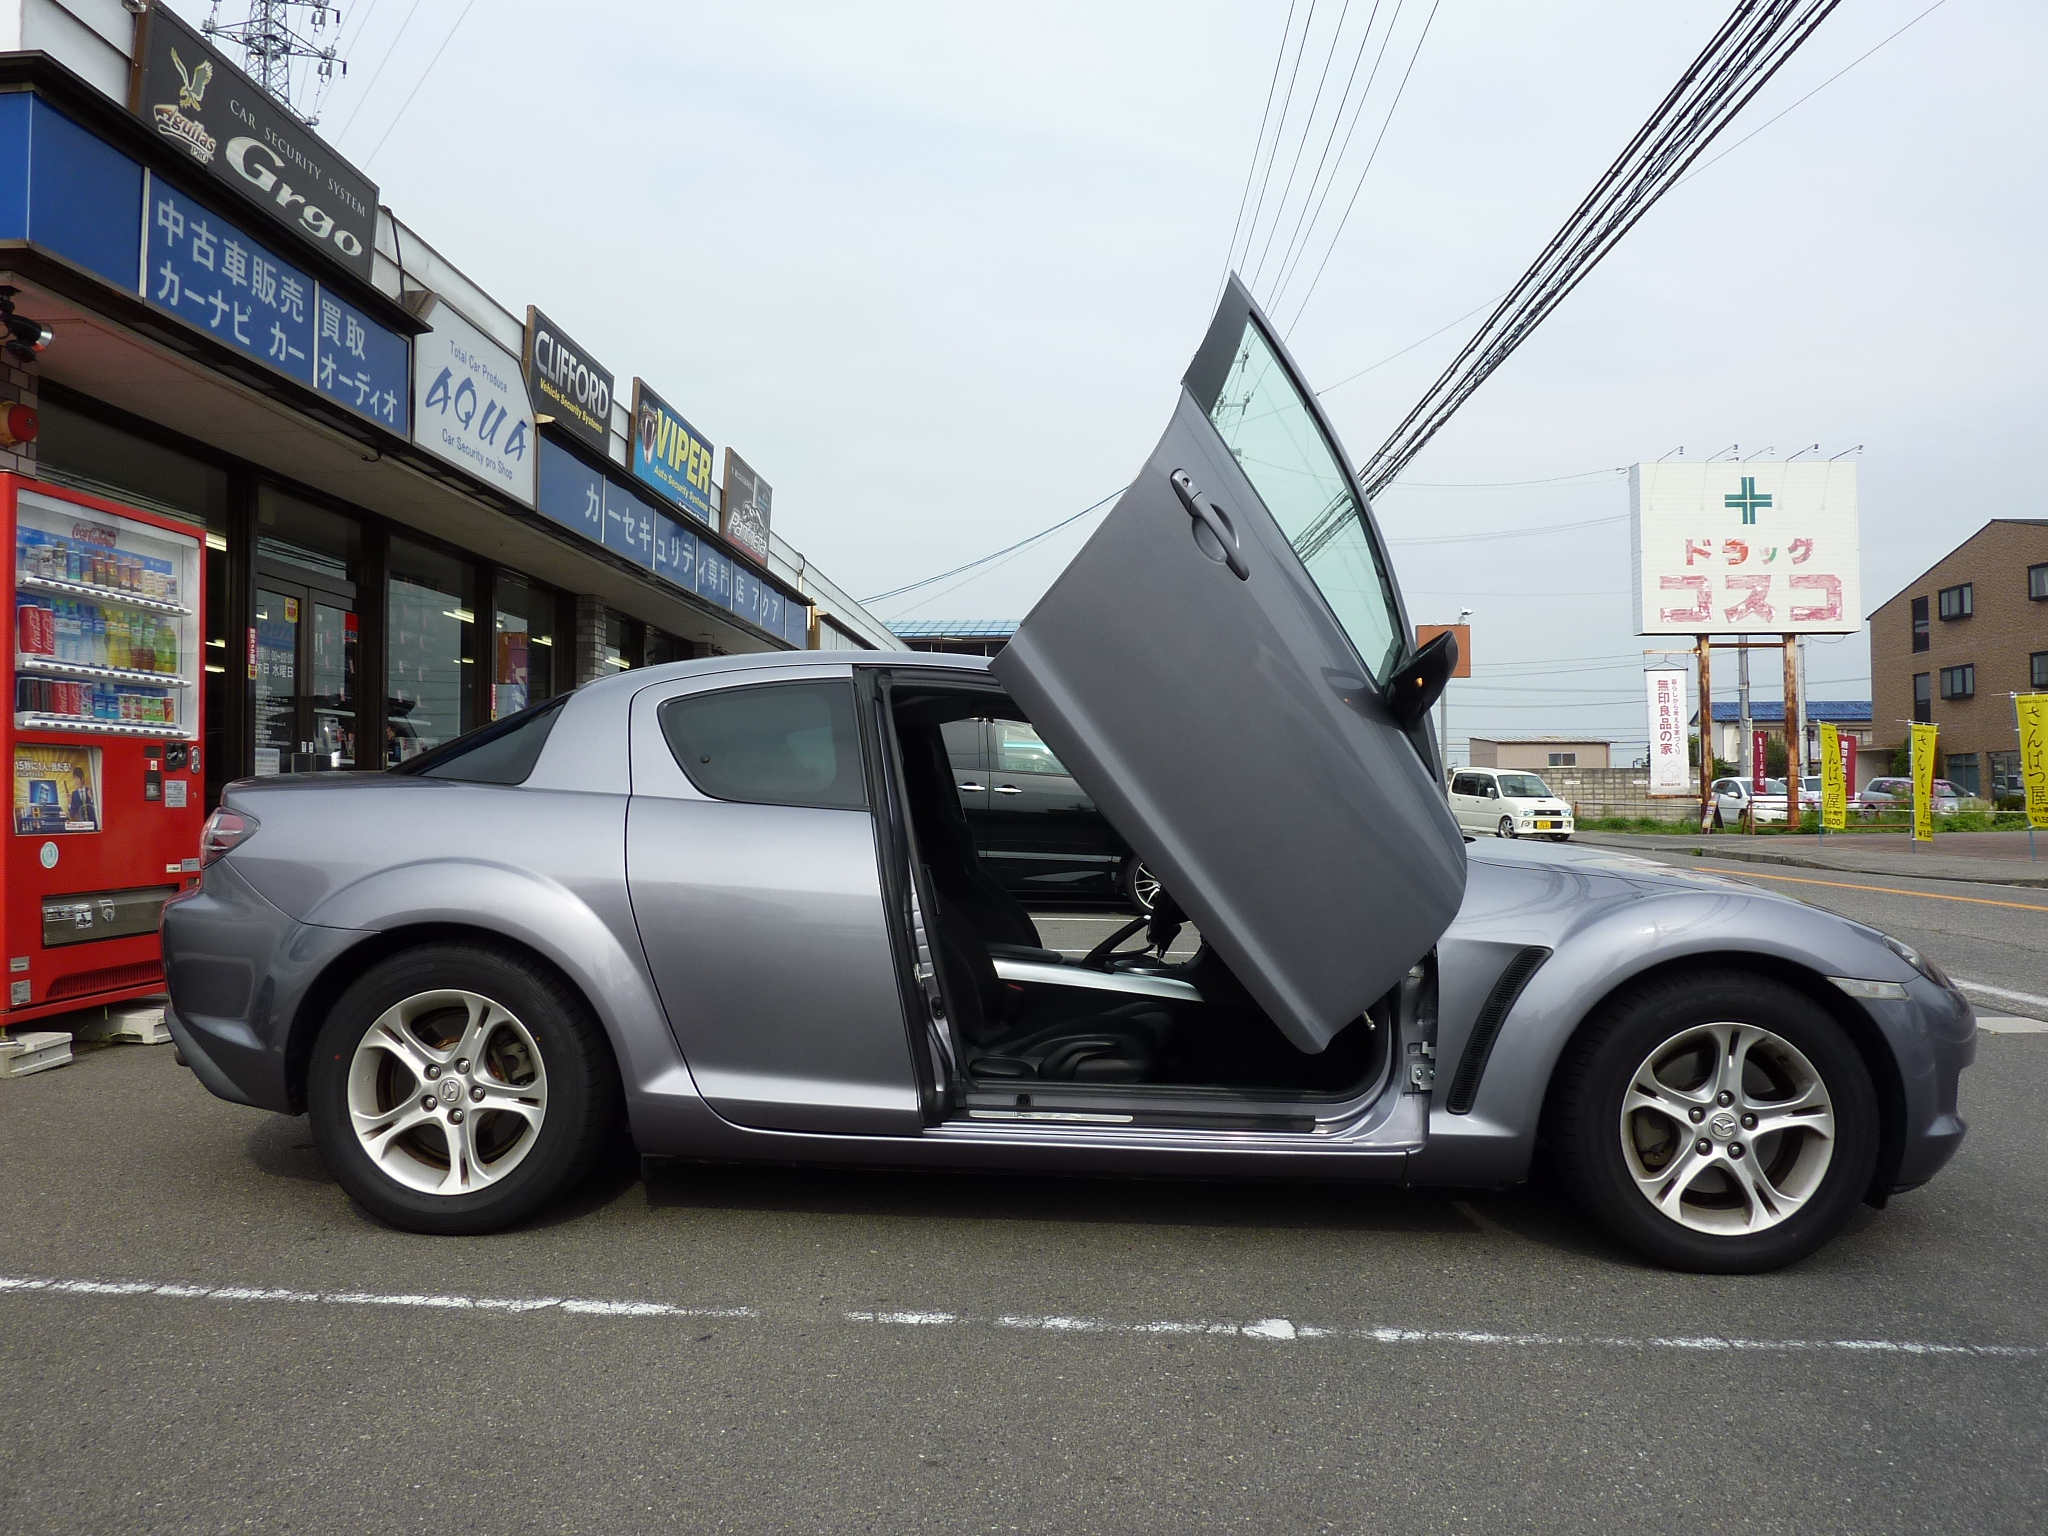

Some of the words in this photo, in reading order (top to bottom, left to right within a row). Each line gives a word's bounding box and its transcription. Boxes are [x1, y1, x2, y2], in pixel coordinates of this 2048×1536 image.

[190, 145, 208, 163] PRO
[225, 136, 363, 257] Grgo
[230, 99, 256, 130] CAR
[264, 127, 322, 180] SECURITY
[328, 178, 366, 217] SYSTEM
[157, 198, 304, 324] 中古車販売
[321, 298, 366, 361] 買取
[157, 260, 252, 346] カーナビ
[269, 321, 305, 362] カー
[320, 353, 398, 423] オーディオ
[450, 339, 467, 363] Total
[468, 354, 481, 373] Car
[482, 364, 508, 393] Produce
[535, 330, 609, 419] CLIFFORD
[425, 366, 528, 462] AQUA
[540, 377, 560, 402] Vehicle
[560, 393, 582, 420] Security
[582, 410, 603, 434] Systems
[442, 428, 455, 447] Car
[456, 438, 484, 466] Security
[485, 457, 497, 471] pro
[497, 460, 513, 481] Shop
[654, 465, 668, 481] Auto
[667, 474, 689, 498] Security
[689, 490, 708, 512] Systems
[656, 407, 712, 494] VIPER
[585, 483, 744, 605] カーセキュリティ専門店
[752, 586, 779, 622] アクア
[1659, 574, 1843, 624] コスコ
[272, 663, 293, 678] 水曜日
[1657, 679, 1673, 755] 無印良品の家
[2026, 706, 2048, 805] さんぱつ屋
